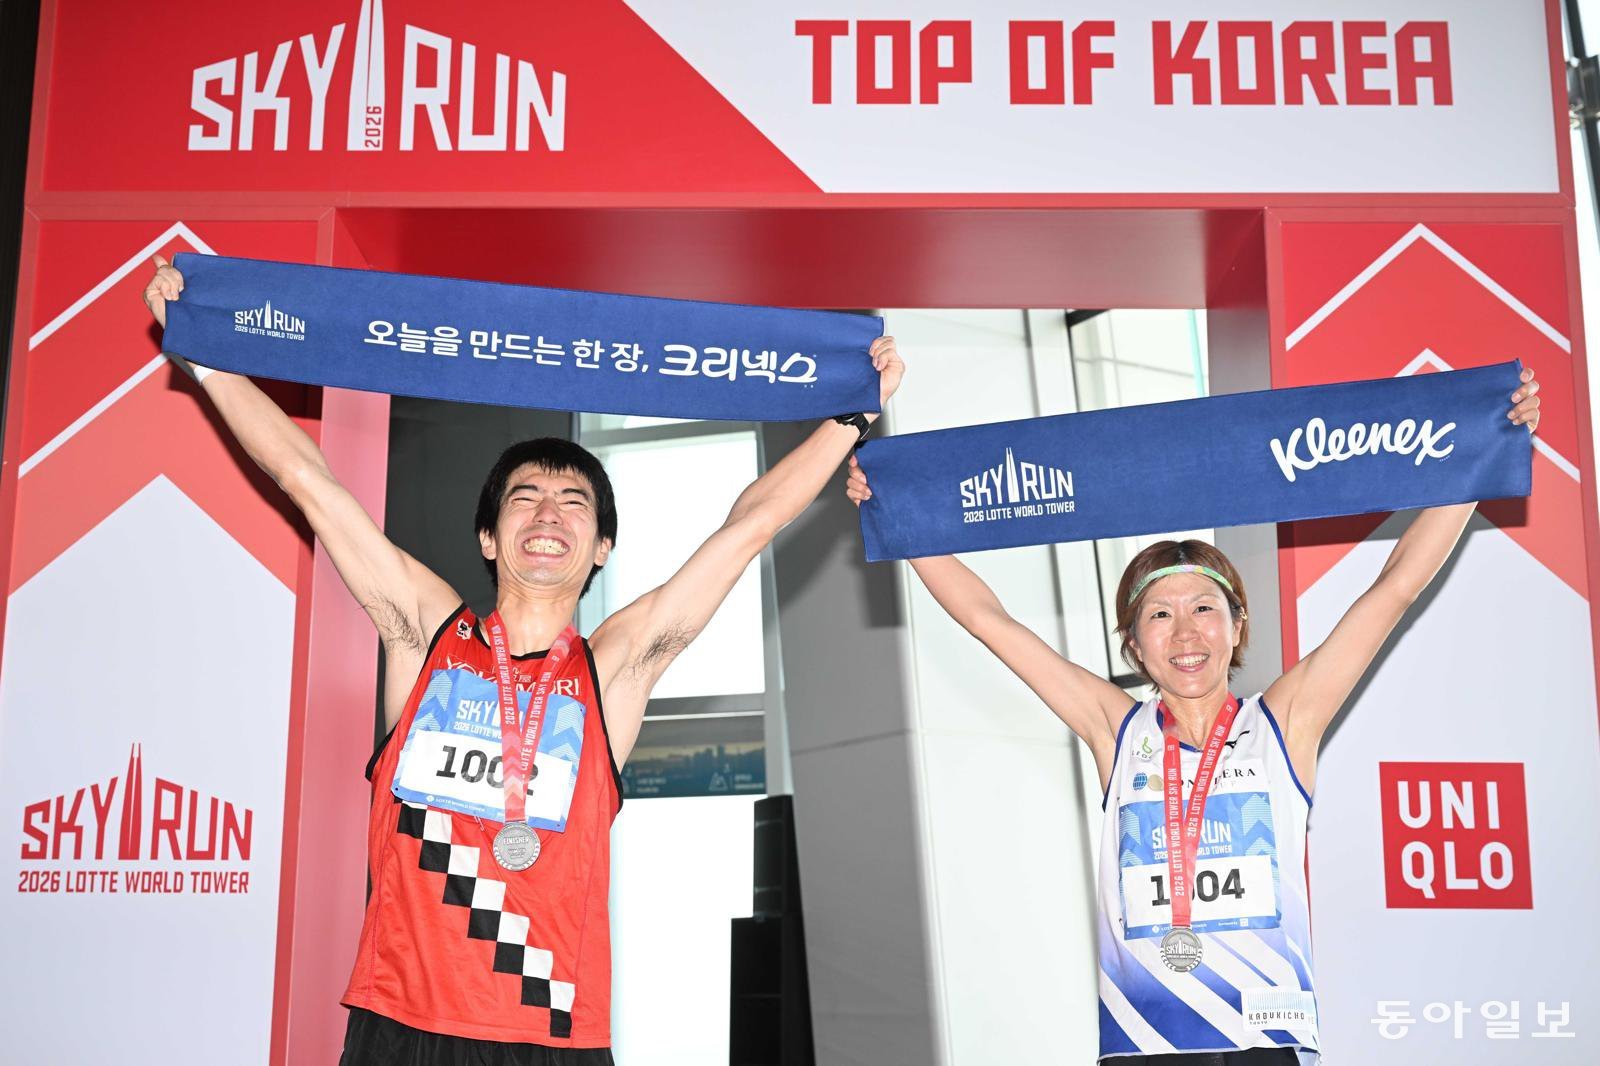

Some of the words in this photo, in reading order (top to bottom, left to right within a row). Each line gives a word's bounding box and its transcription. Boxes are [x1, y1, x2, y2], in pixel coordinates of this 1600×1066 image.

[796, 20, 972, 104] TOP
[1008, 20, 1114, 104] OF
[1152, 21, 1453, 105] KOREA
[188, 23, 345, 151] SKY
[400, 24, 566, 151] RUN
[365, 105, 382, 148] 2026
[234, 308, 264, 328] SKY
[273, 309, 305, 333] RUN
[248, 327, 266, 336] LOTTE
[266, 330, 286, 339] WORLD
[286, 333, 305, 341] TOWER
[364, 320, 462, 357] 오늘을
[470, 331, 566, 366] 만드는
[572, 339, 605, 369] 한
[610, 342, 649, 373] 장,
[659, 344, 818, 384] 크리넥스
[1270, 417, 1456, 482] Kleenex
[960, 463, 1003, 508] SKY
[1020, 461, 1074, 501] RUN
[963, 511, 984, 523] 2026
[986, 507, 1012, 520] LOTTE
[1013, 504, 1043, 518] WORLD
[1044, 500, 1075, 515] TOWER
[456, 699, 495, 725] SKY
[524, 720, 539, 746] WORLD
[1210, 735, 1221, 748] SKY
[1203, 747, 1217, 769] TOWER
[1168, 782, 1178, 795] SKY
[1197, 769, 1209, 792] WORLD
[1169, 795, 1179, 820] TOWER
[1191, 794, 1202, 815] LOTTE
[1397, 780, 1500, 829] UNI
[21, 776, 119, 860] SKY
[150, 777, 253, 861] RUN
[1187, 816, 1198, 837] 2026
[1170, 821, 1180, 847] WORLD
[1172, 849, 1183, 872] LOTTE
[1401, 841, 1514, 899] QLO
[18, 871, 61, 892] 2026
[66, 871, 118, 893] LOTTE
[125, 871, 183, 893] WORLD
[190, 871, 249, 894] TOWER
[1151, 868, 1245, 906] 104
[1174, 875, 1185, 897] 2026
[1166, 943, 1179, 955] SKY
[1182, 943, 1197, 955] RUN
